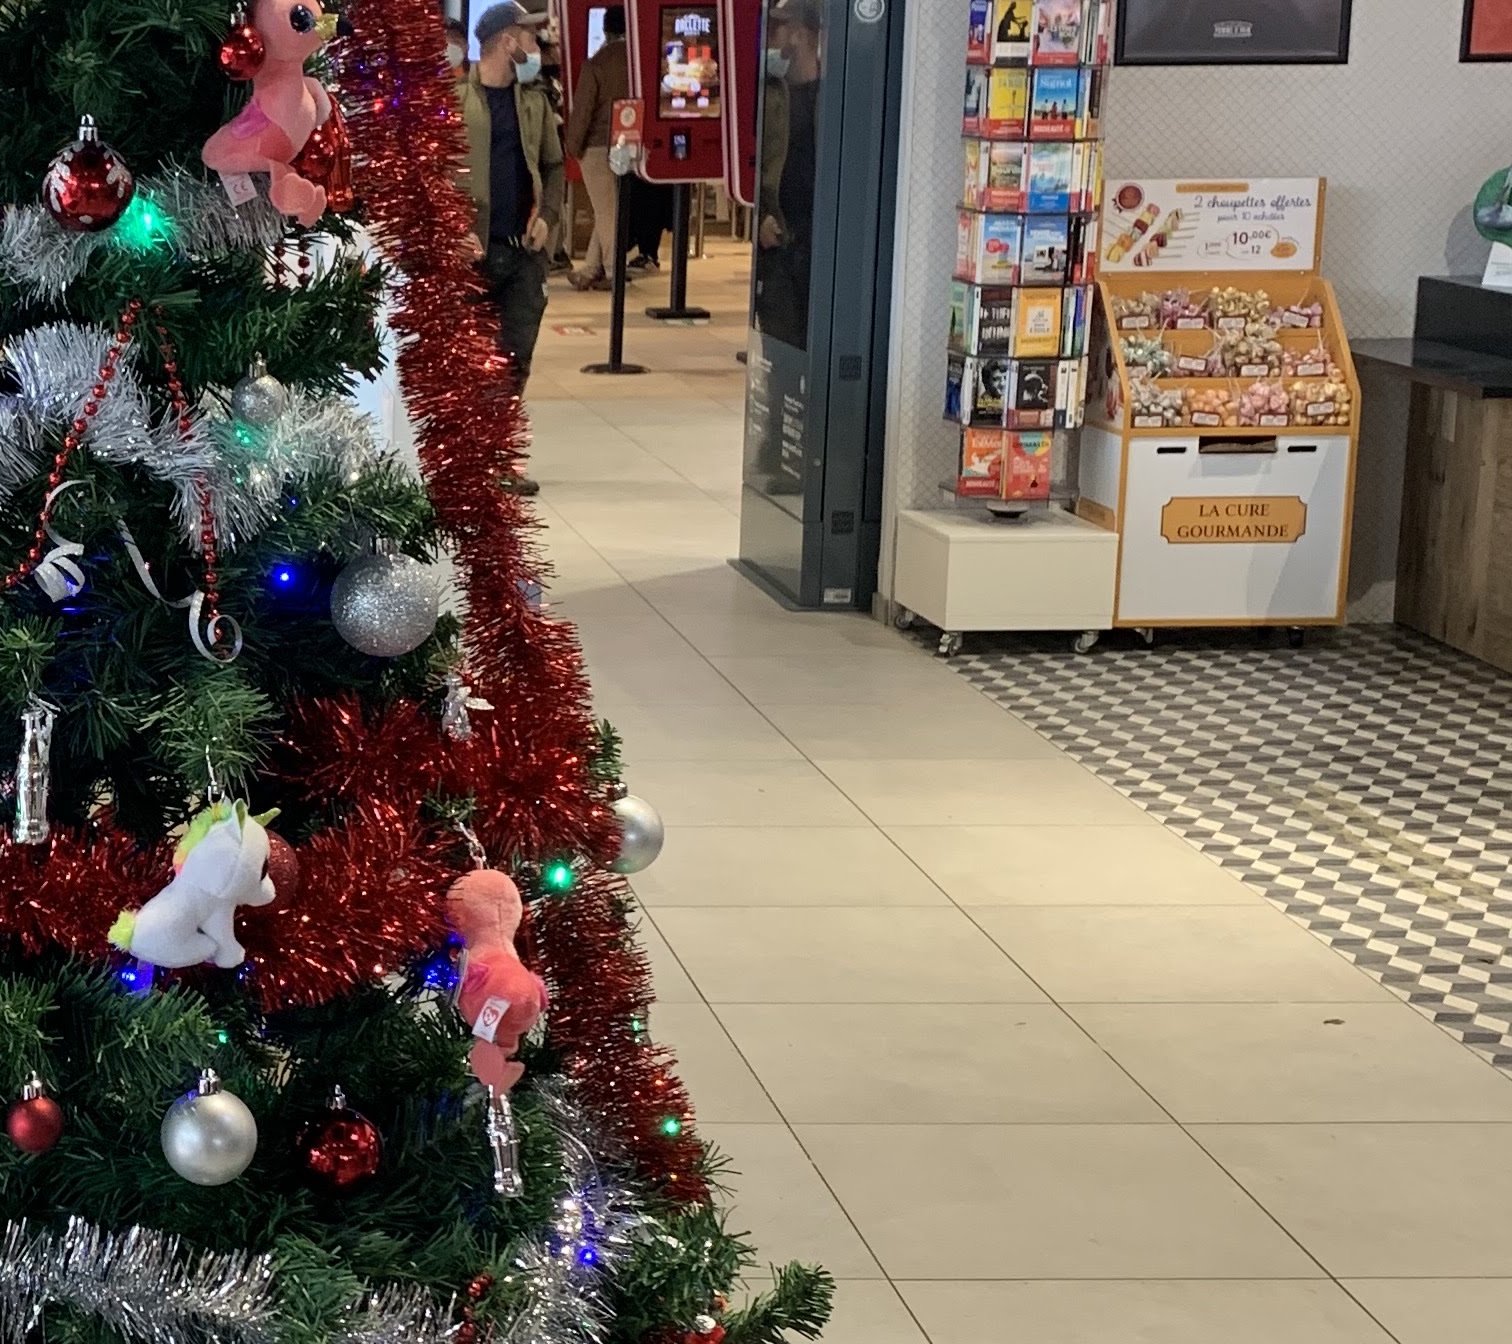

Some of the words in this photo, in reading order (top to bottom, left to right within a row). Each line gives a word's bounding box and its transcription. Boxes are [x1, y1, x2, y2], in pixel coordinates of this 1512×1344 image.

[1199, 504, 1219, 517] LA
[1225, 503, 1270, 517] CURE
[1177, 524, 1288, 539] GOURMANDE
